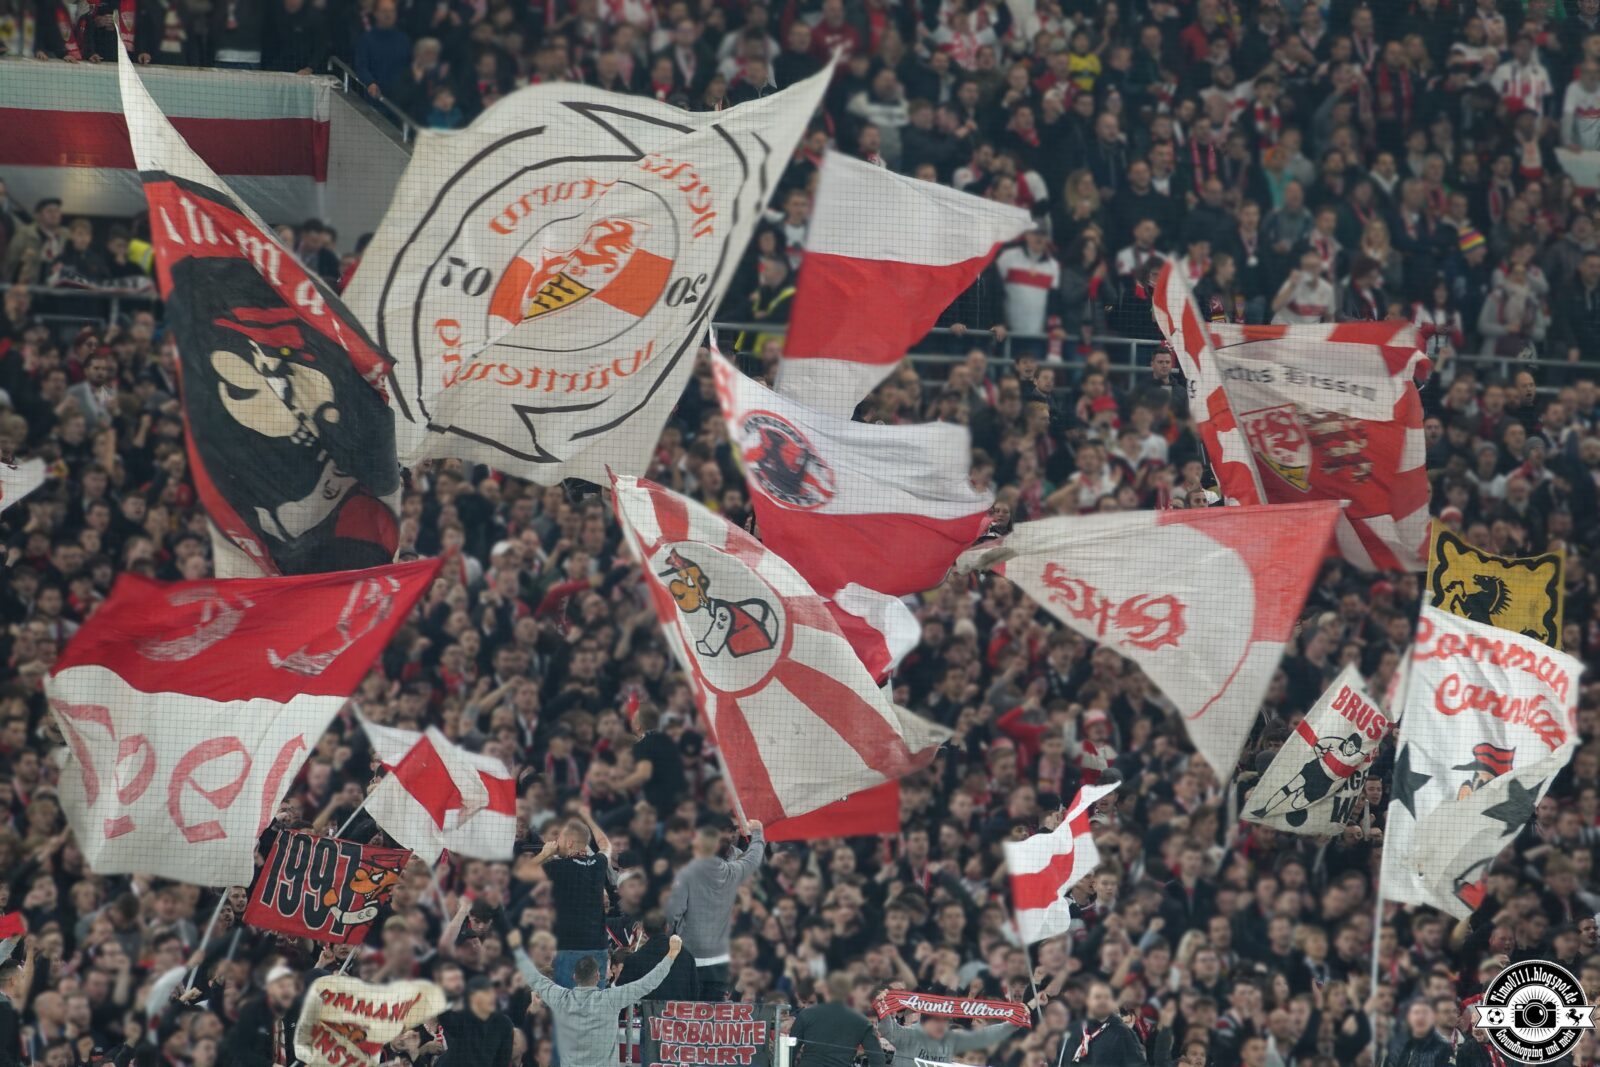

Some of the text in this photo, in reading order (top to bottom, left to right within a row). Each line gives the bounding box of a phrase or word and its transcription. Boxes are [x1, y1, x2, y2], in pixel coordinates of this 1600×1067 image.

[260, 829, 362, 936] 1997
[662, 1001, 754, 1021] JEDER
[898, 995, 954, 1014] Avanti
[960, 1001, 1014, 1018] Ultras
[648, 1016, 766, 1045] VERBANNTE
[660, 1042, 757, 1065] KEHRT
